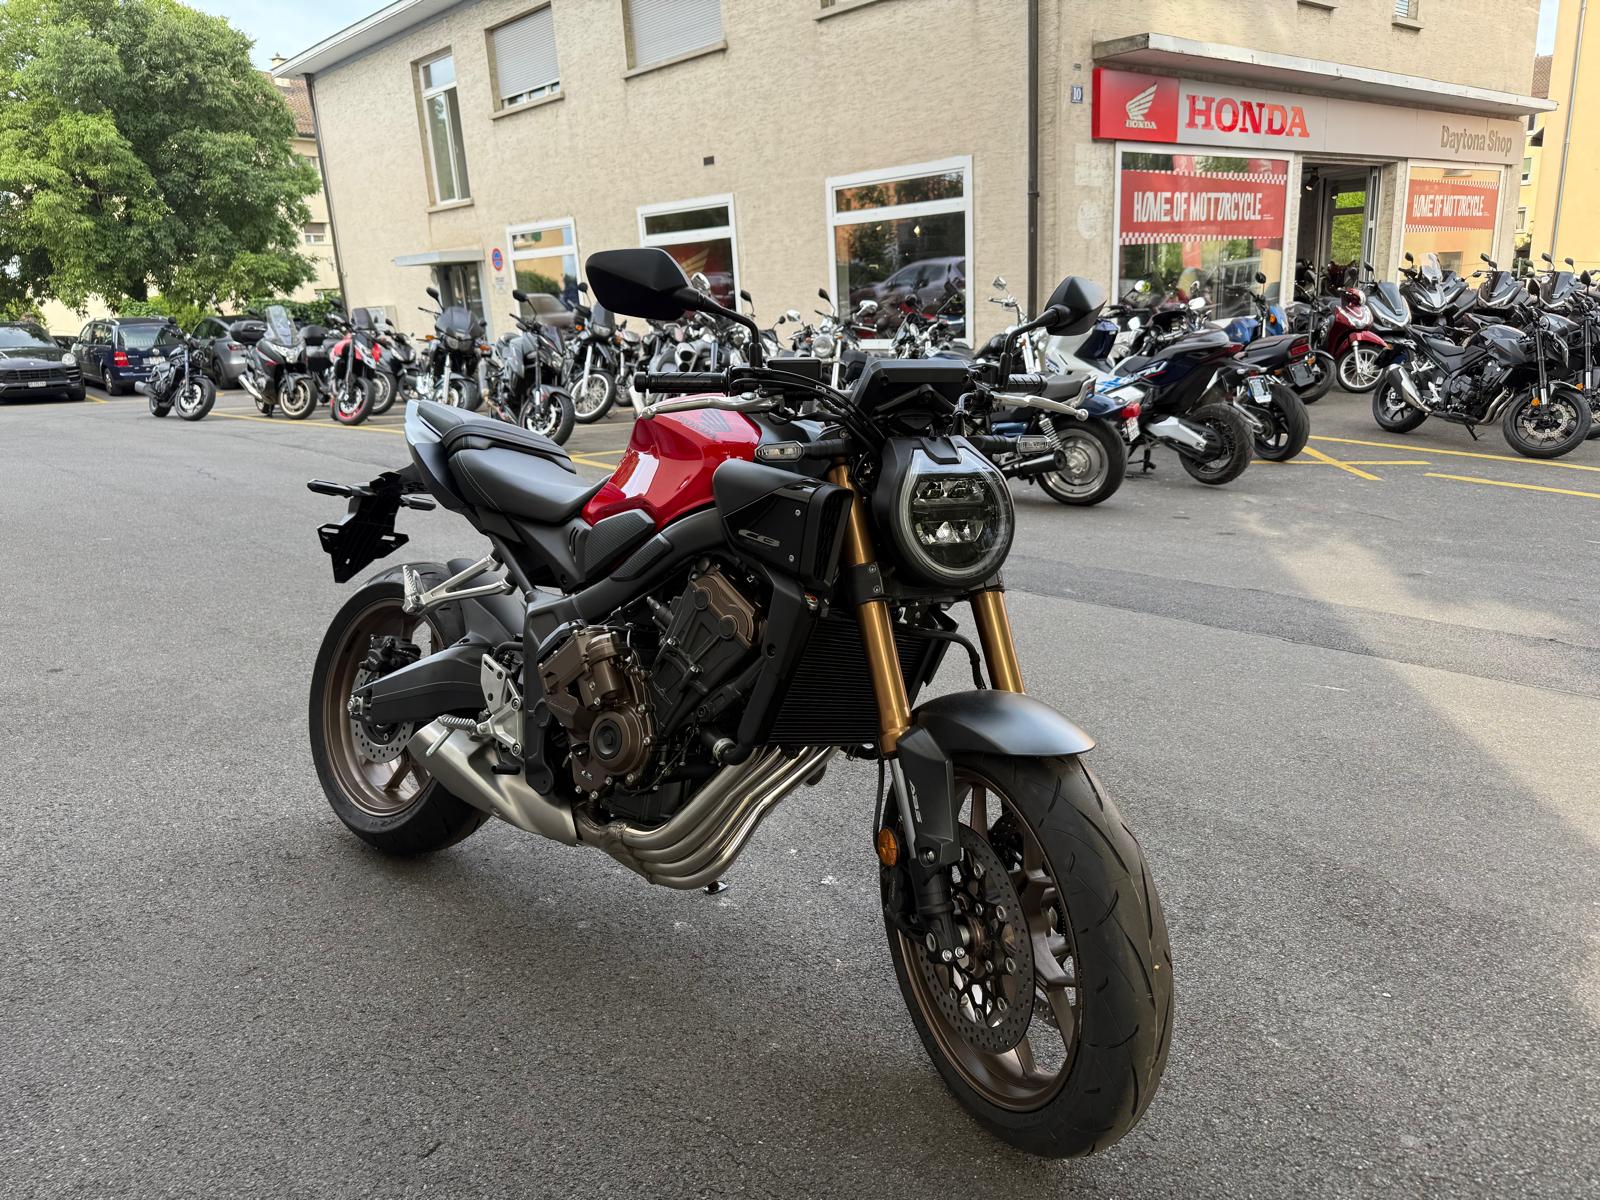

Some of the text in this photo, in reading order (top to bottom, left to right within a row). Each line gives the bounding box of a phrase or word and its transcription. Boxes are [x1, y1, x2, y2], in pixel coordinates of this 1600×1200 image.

[1073, 87, 1082, 101] 10
[1125, 120, 1157, 130] HONDA
[1185, 94, 1310, 138] HONDA
[1440, 125, 1513, 157] Daytona Shop
[1133, 191, 1172, 223] HOME
[1173, 192, 1188, 223] OF
[1412, 194, 1435, 217] HOME
[1434, 194, 1443, 217] OF
